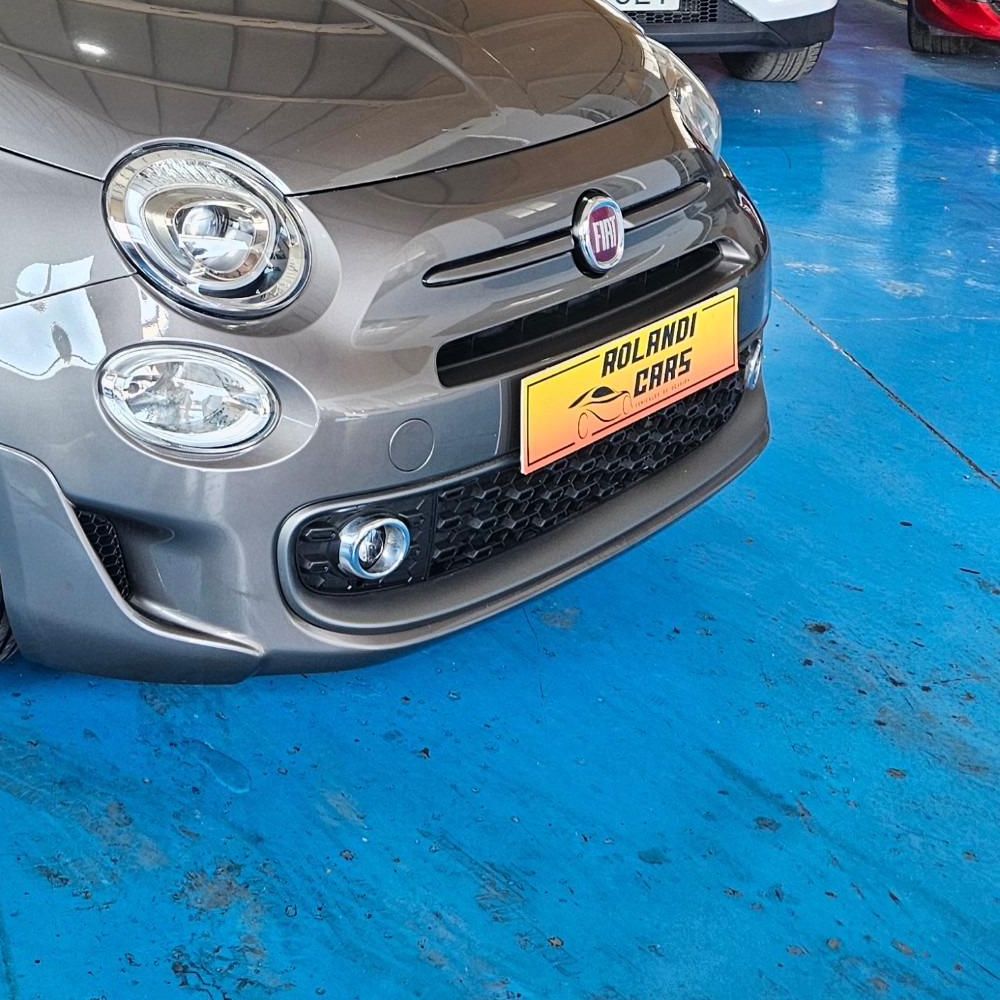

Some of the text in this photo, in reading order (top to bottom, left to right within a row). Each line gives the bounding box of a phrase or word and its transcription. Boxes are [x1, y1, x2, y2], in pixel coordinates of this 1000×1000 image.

[592, 215, 617, 253] FIAT
[601, 311, 698, 378] ROLANDI
[633, 347, 693, 397] CARS
